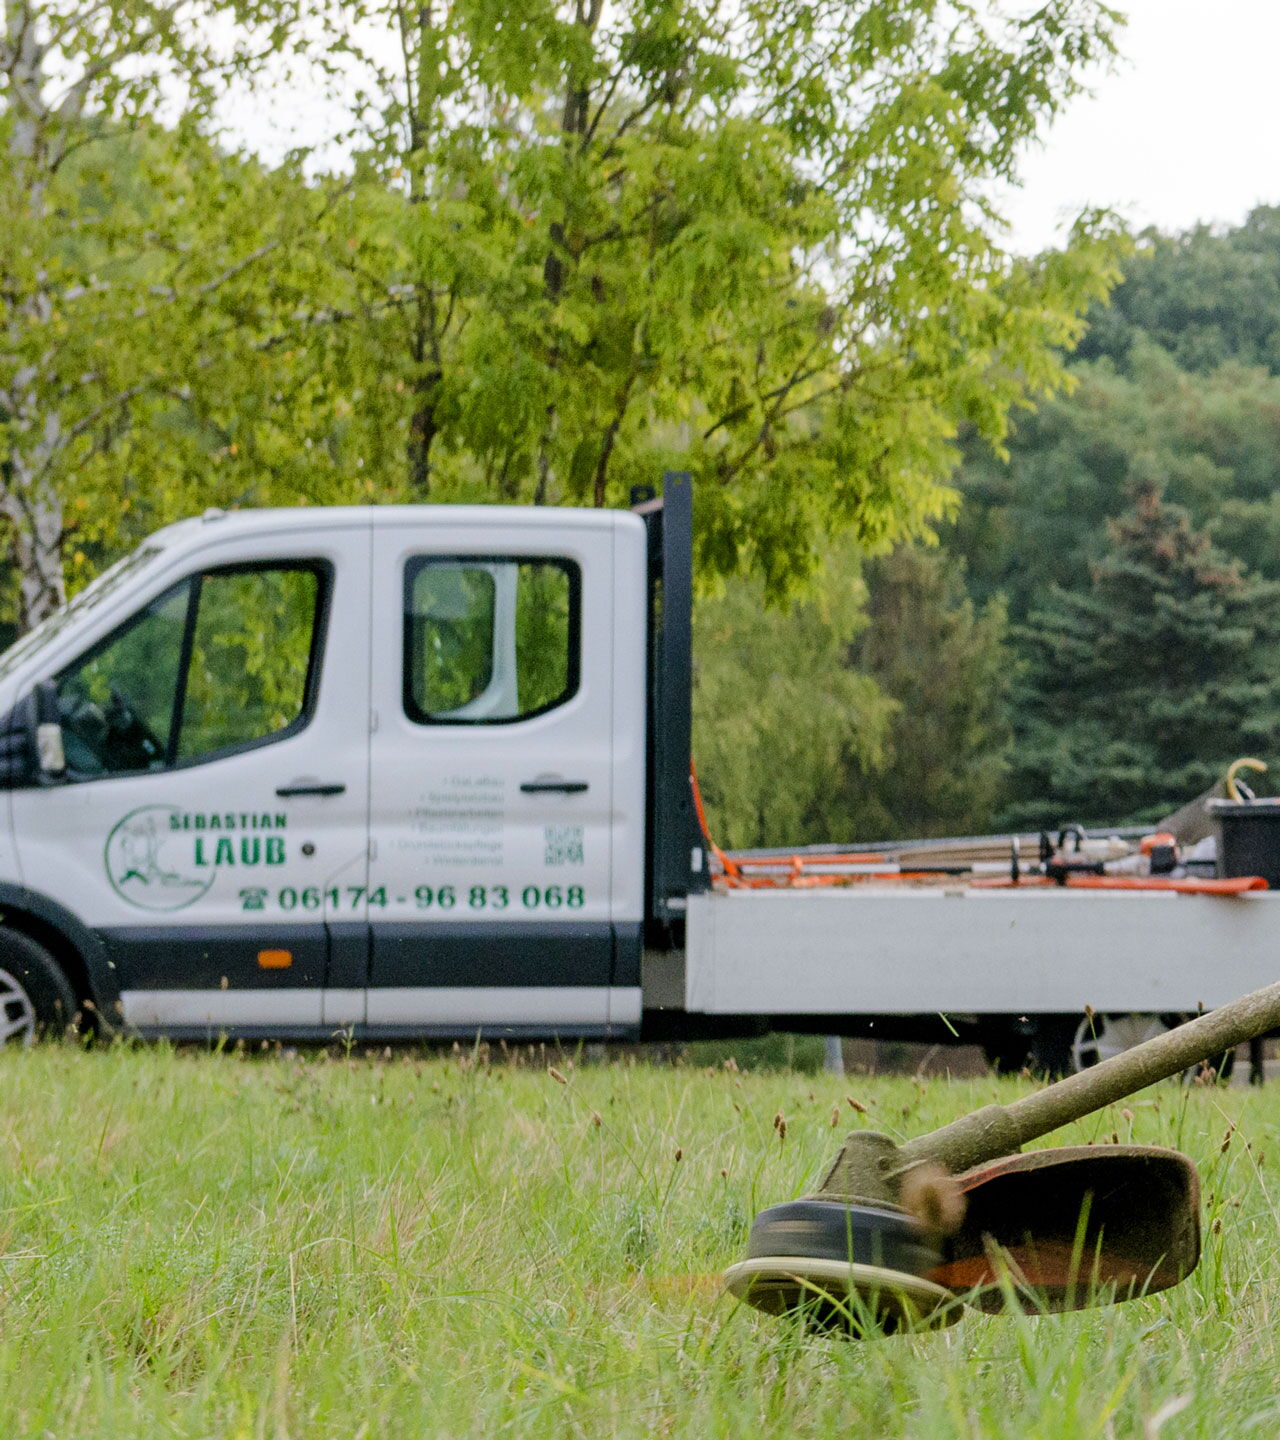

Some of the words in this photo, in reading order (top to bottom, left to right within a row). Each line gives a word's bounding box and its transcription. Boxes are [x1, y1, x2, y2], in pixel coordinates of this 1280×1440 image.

[169, 813, 287, 830] SEBASTIAN
[195, 837, 286, 866] LAUB
[278, 885, 386, 910] 06174
[414, 885, 456, 909] 96
[469, 885, 510, 909] 83
[522, 885, 585, 909] 068
